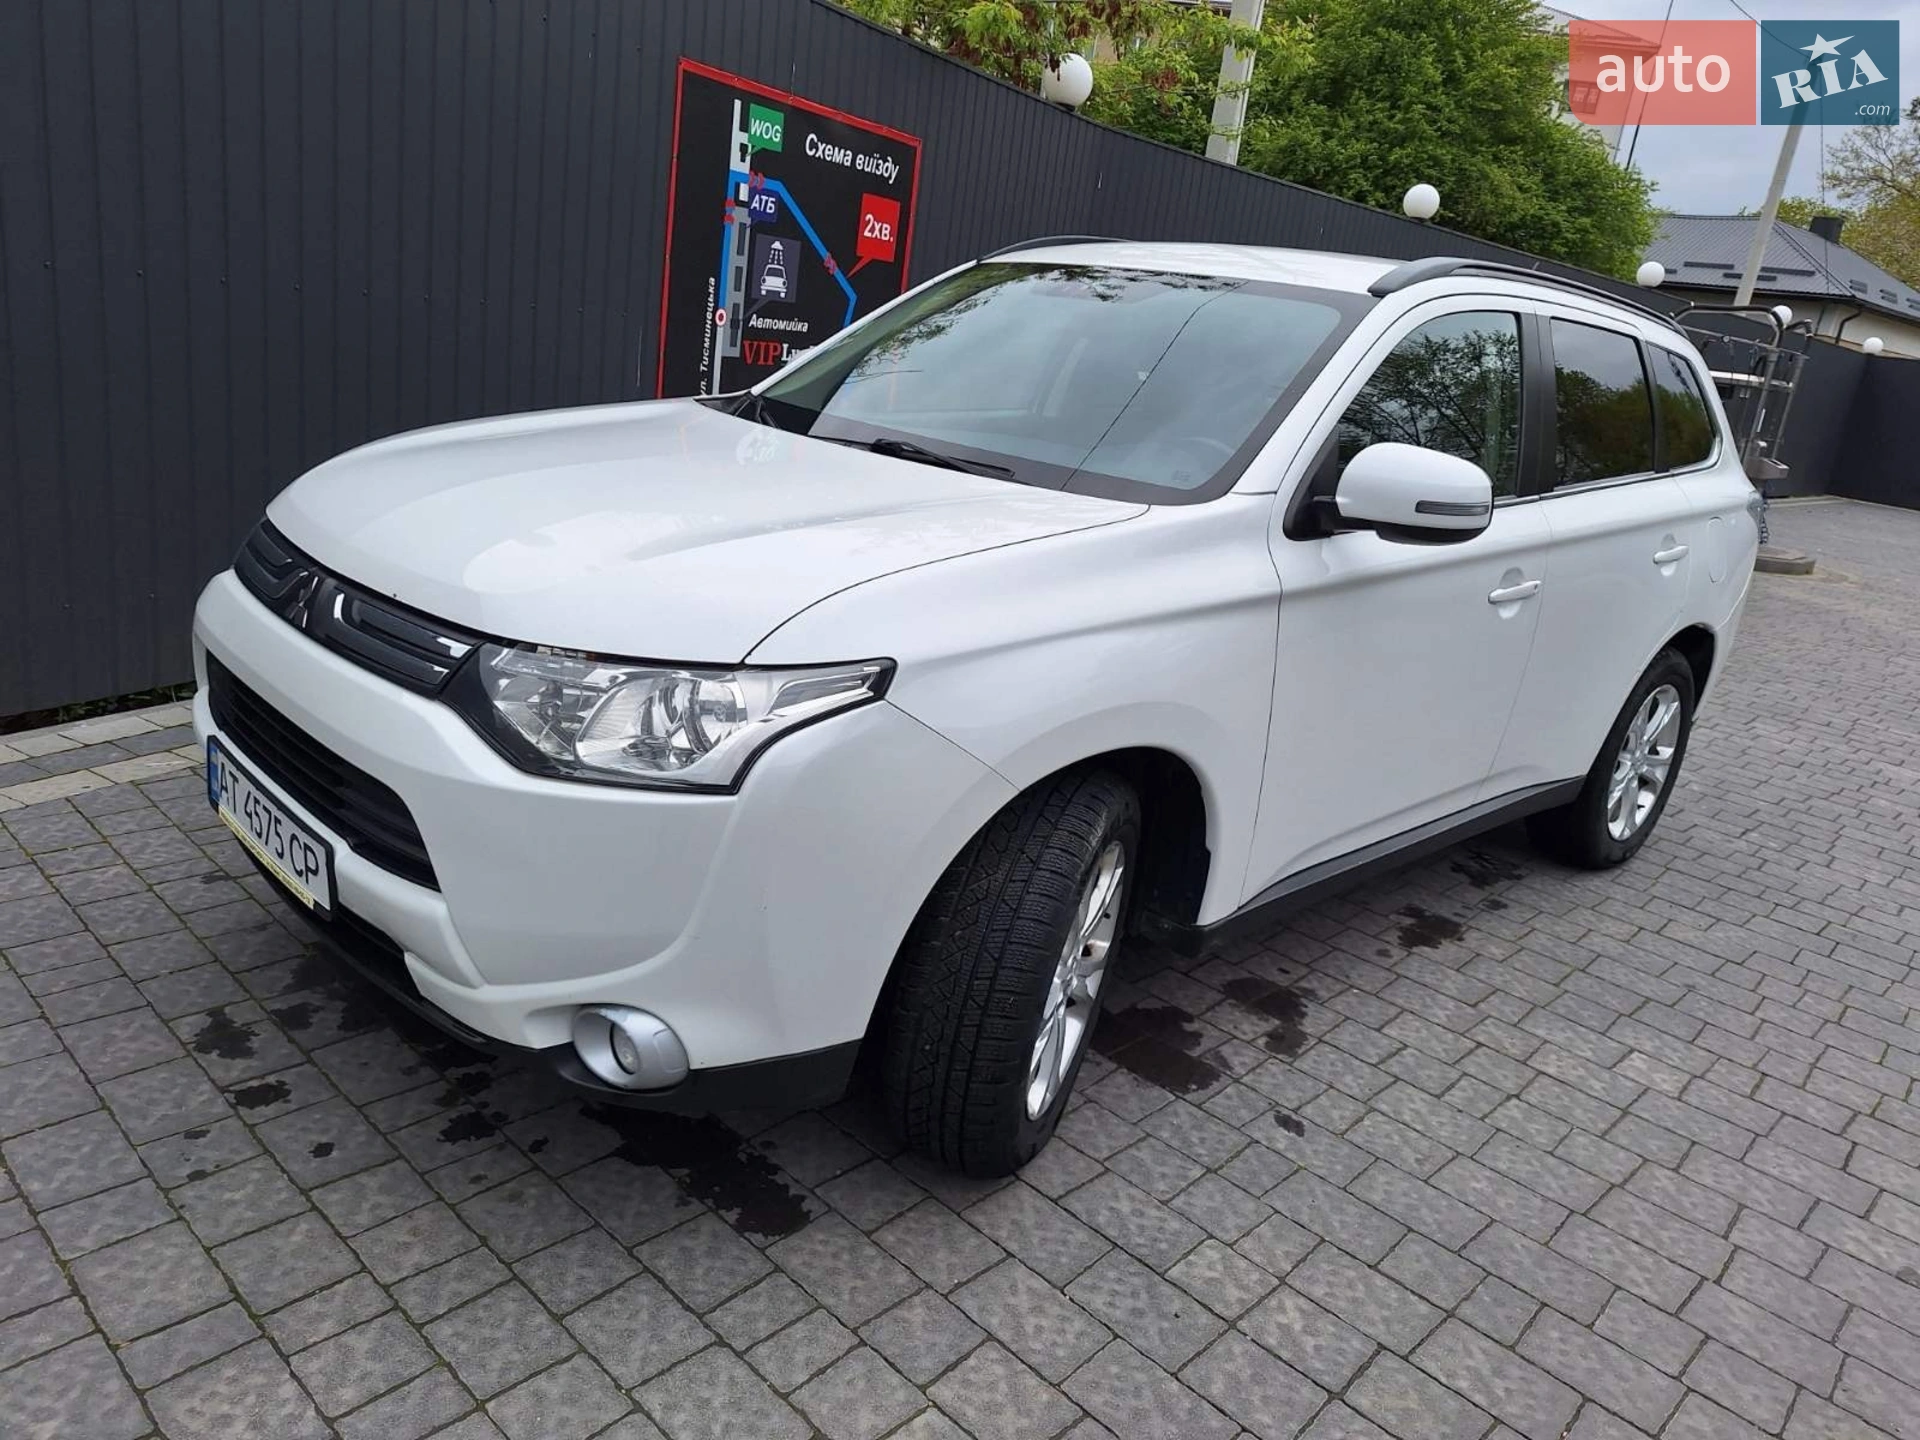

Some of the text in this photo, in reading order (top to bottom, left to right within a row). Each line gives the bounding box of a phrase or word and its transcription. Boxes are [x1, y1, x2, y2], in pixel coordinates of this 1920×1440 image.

[750, 118, 782, 143] WOG
[805, 133, 900, 184] Схема виїзду
[750, 194, 776, 213] АТБ
[748, 313, 809, 332] Автомийка
[219, 761, 239, 815] AT
[244, 790, 285, 860] 4575
[289, 832, 320, 885] CP
